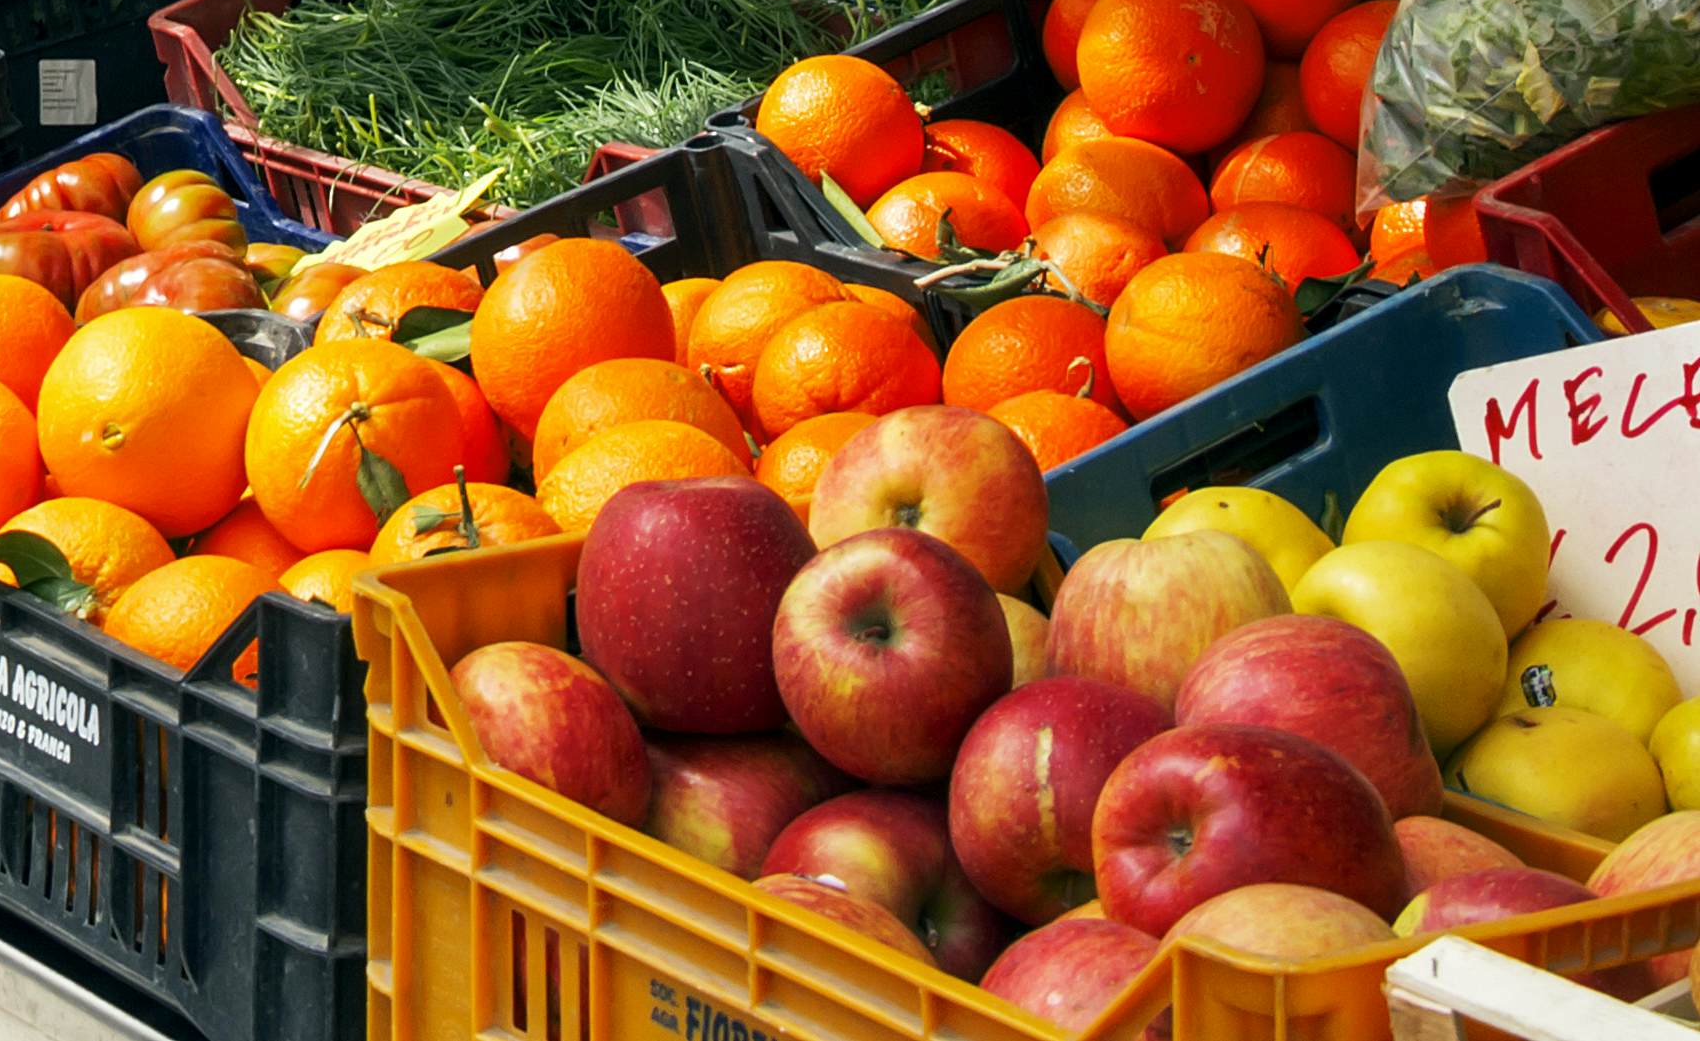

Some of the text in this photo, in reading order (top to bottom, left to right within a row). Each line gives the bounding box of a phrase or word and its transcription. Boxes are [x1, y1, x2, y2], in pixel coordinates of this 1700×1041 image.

[12, 663, 100, 747] AGRICOLA
[16, 719, 27, 740] &
[27, 723, 72, 765] FRANCA
[685, 995, 778, 1041] FIOR
